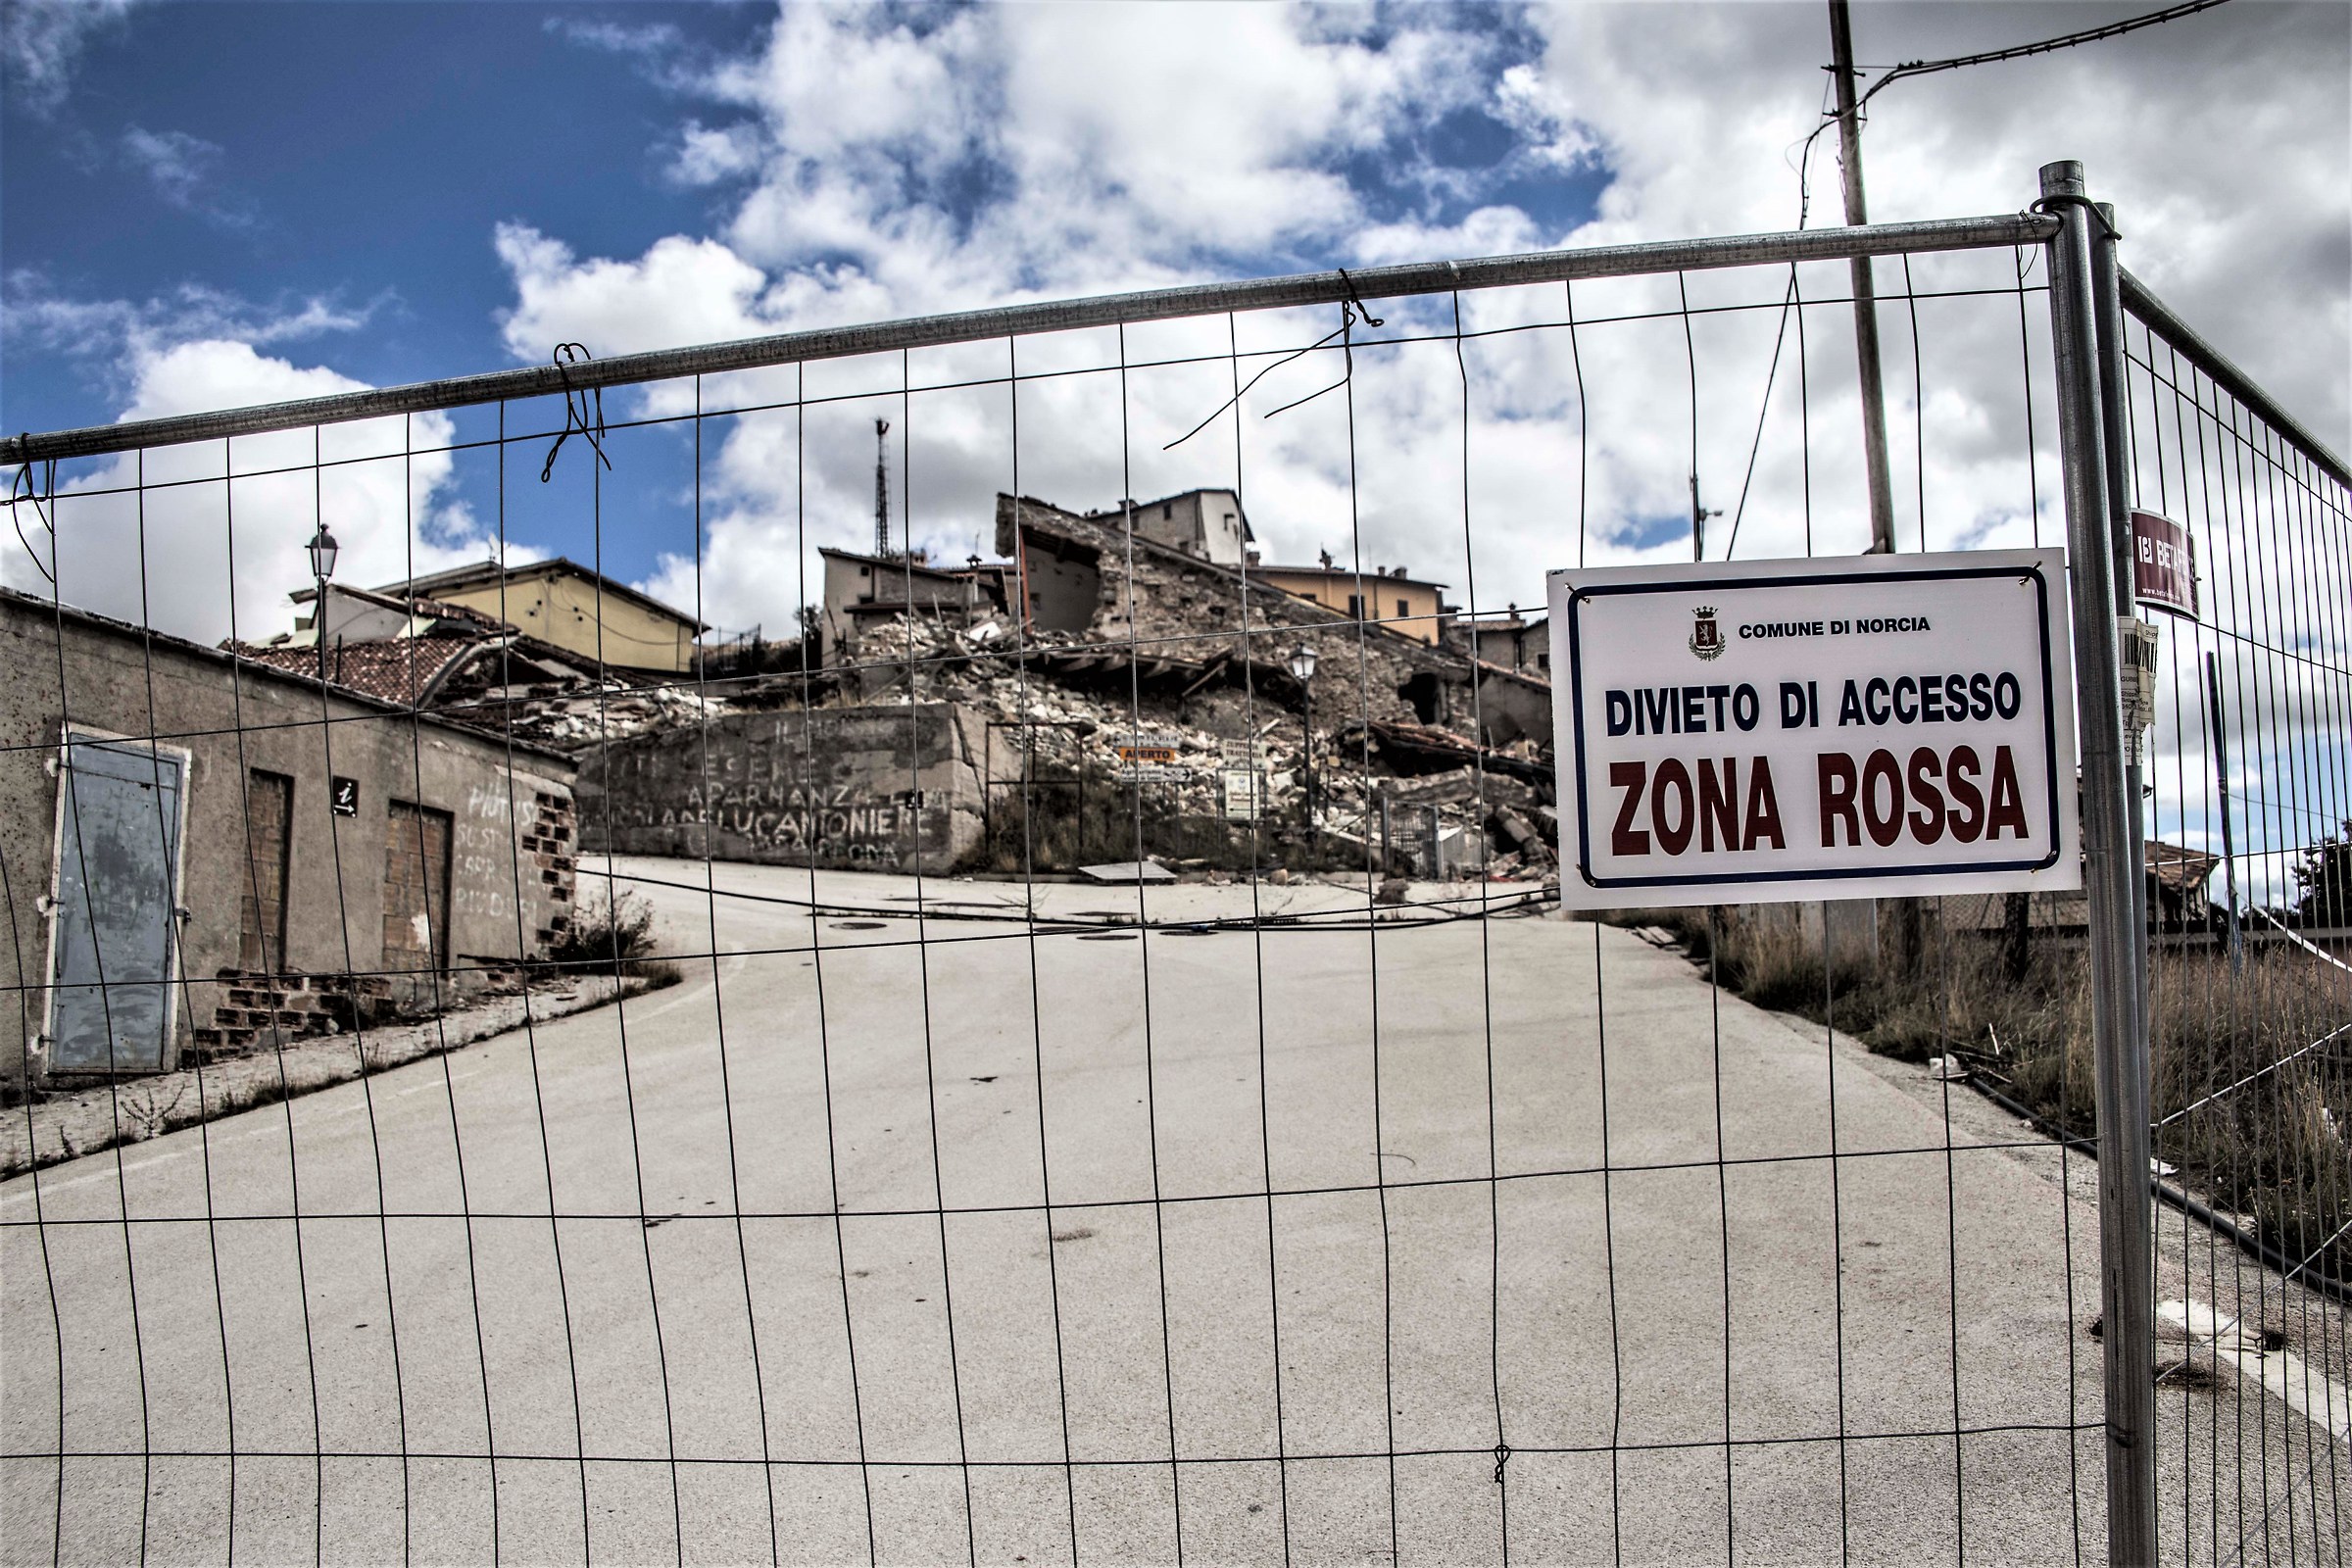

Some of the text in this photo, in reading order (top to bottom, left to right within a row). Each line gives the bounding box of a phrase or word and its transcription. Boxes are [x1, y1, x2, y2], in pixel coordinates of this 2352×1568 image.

[1738, 616, 1932, 639] COMUNE DI NORCIA
[1605, 671, 2022, 737] DIVIETO DI ACCESSO
[1125, 749, 1170, 760] APERTO
[1609, 744, 2030, 857] ZONA ROSSA
